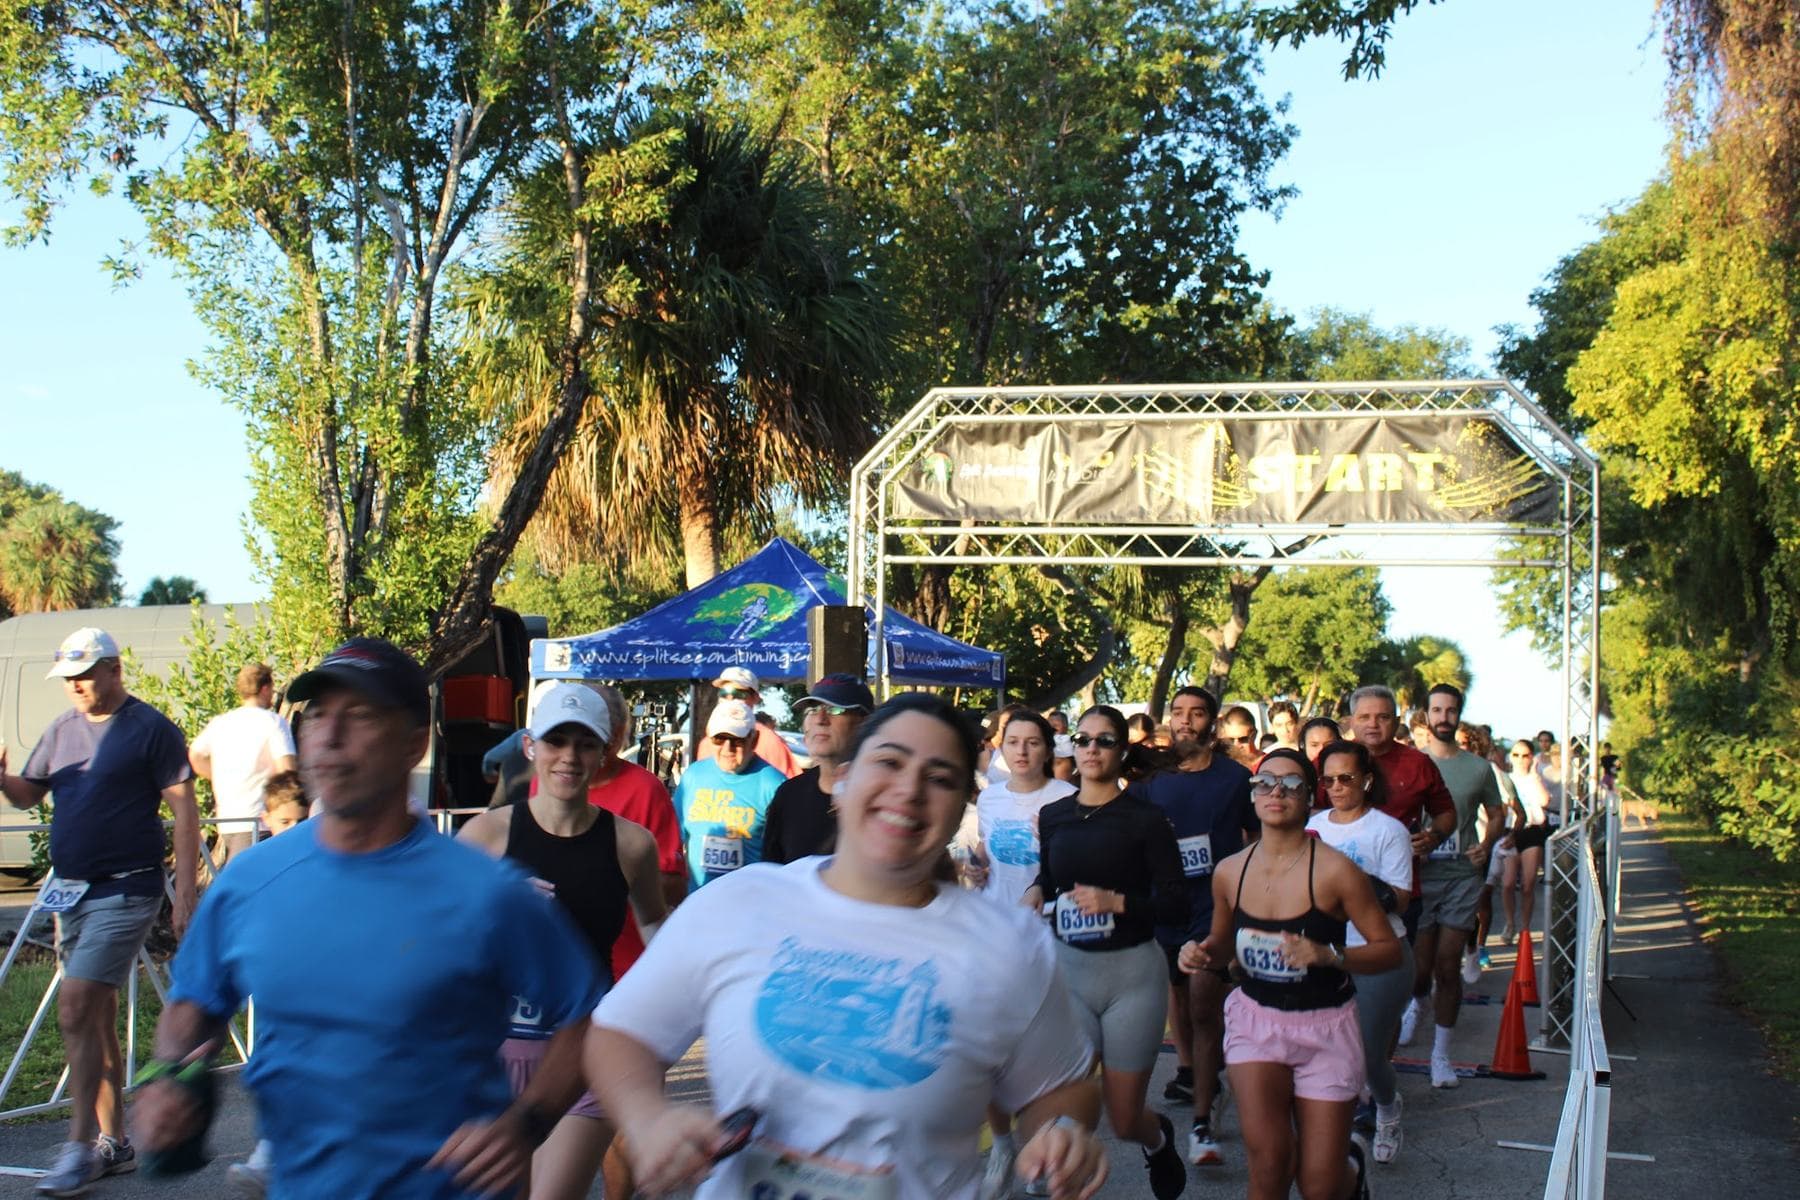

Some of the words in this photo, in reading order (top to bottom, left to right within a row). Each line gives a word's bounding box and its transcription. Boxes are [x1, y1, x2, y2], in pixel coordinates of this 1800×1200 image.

[1248, 452, 1442, 492] START
[704, 848, 739, 866] 6504
[1244, 947, 1300, 972] 633
